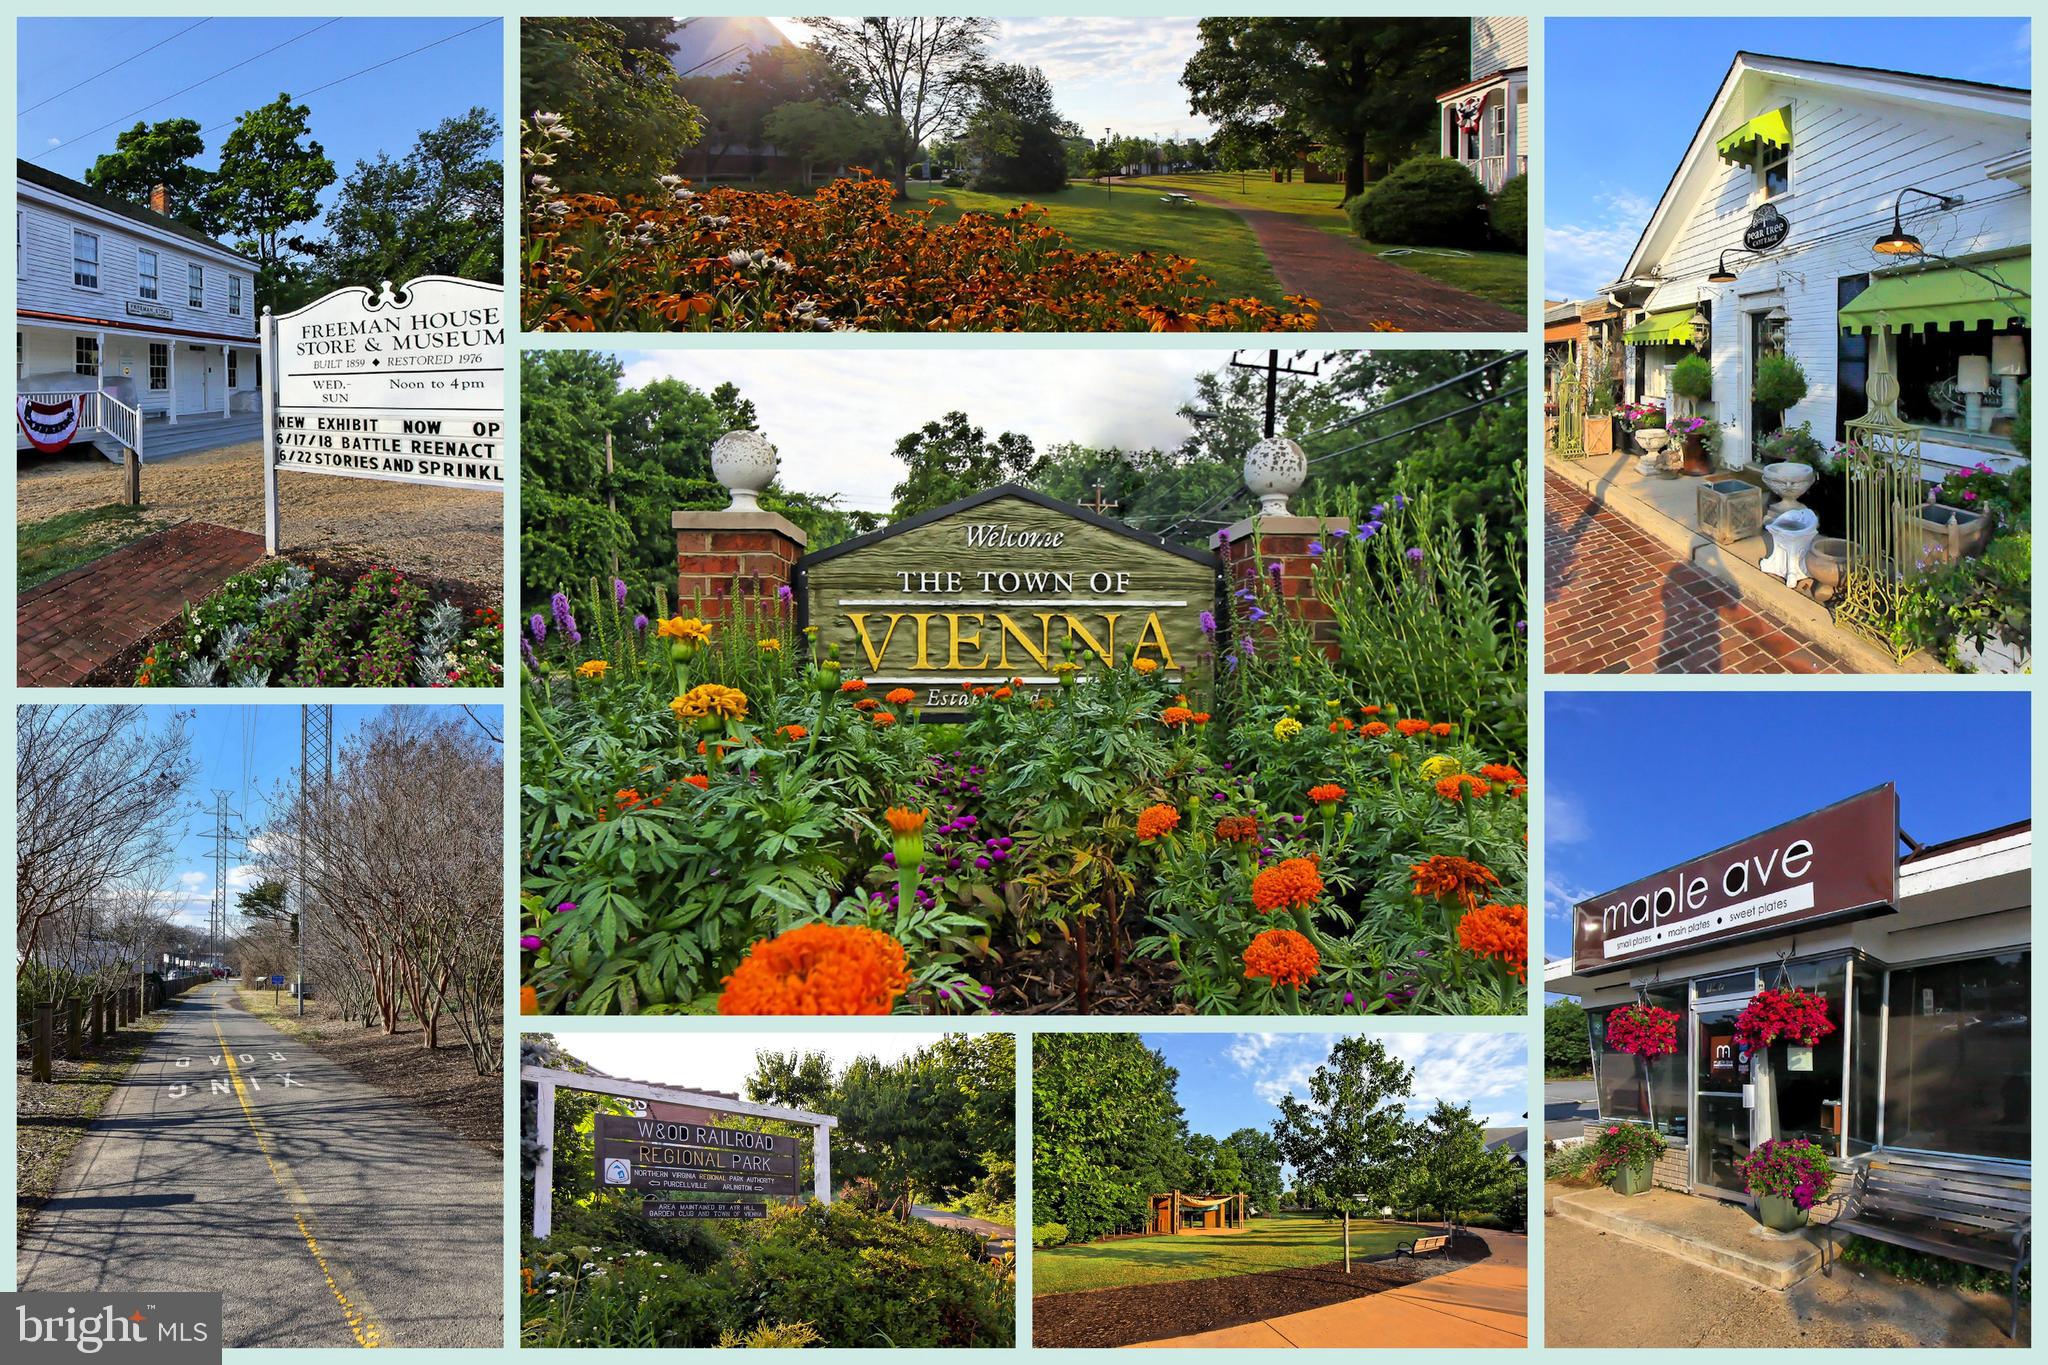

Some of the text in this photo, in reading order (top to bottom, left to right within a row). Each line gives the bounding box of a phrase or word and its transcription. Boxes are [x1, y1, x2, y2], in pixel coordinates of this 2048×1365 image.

[301, 308, 500, 340] FREEMAN HOUSE
[297, 328, 504, 356] STORE & MUSEUM
[313, 353, 483, 370] BUILT 1859 RESTORED 1976
[390, 379, 425, 389] Noon
[431, 379, 445, 389] to
[322, 393, 349, 403] SUN
[278, 416, 500, 437] NEW EXHIBIT NOW OP
[276, 433, 495, 458] 6/17/18 BATTLE REENACT
[279, 450, 504, 481] 6/22 STORIES AND SPRINKL
[964, 523, 1065, 549] Welcome
[896, 571, 1131, 594] THE TOWN OF
[843, 611, 1181, 673] VIENNA
[1602, 839, 1814, 933] maple ave
[1616, 898, 1788, 951] small plates main plates sweet plates
[175, 1051, 287, 1068] ROAD
[168, 1072, 304, 1099] XING
[637, 1121, 774, 1151] W&OD RAILROAD
[639, 1145, 771, 1172] REGIONAL PARK
[634, 1170, 669, 1178] NORTHERN
[672, 1171, 697, 1179] VIRGINIA
[699, 1173, 727, 1181] REGIONAL
[746, 1176, 775, 1185] AUTHORITY
[663, 1181, 753, 1192] PURCELLVILLE ARLINGTON
